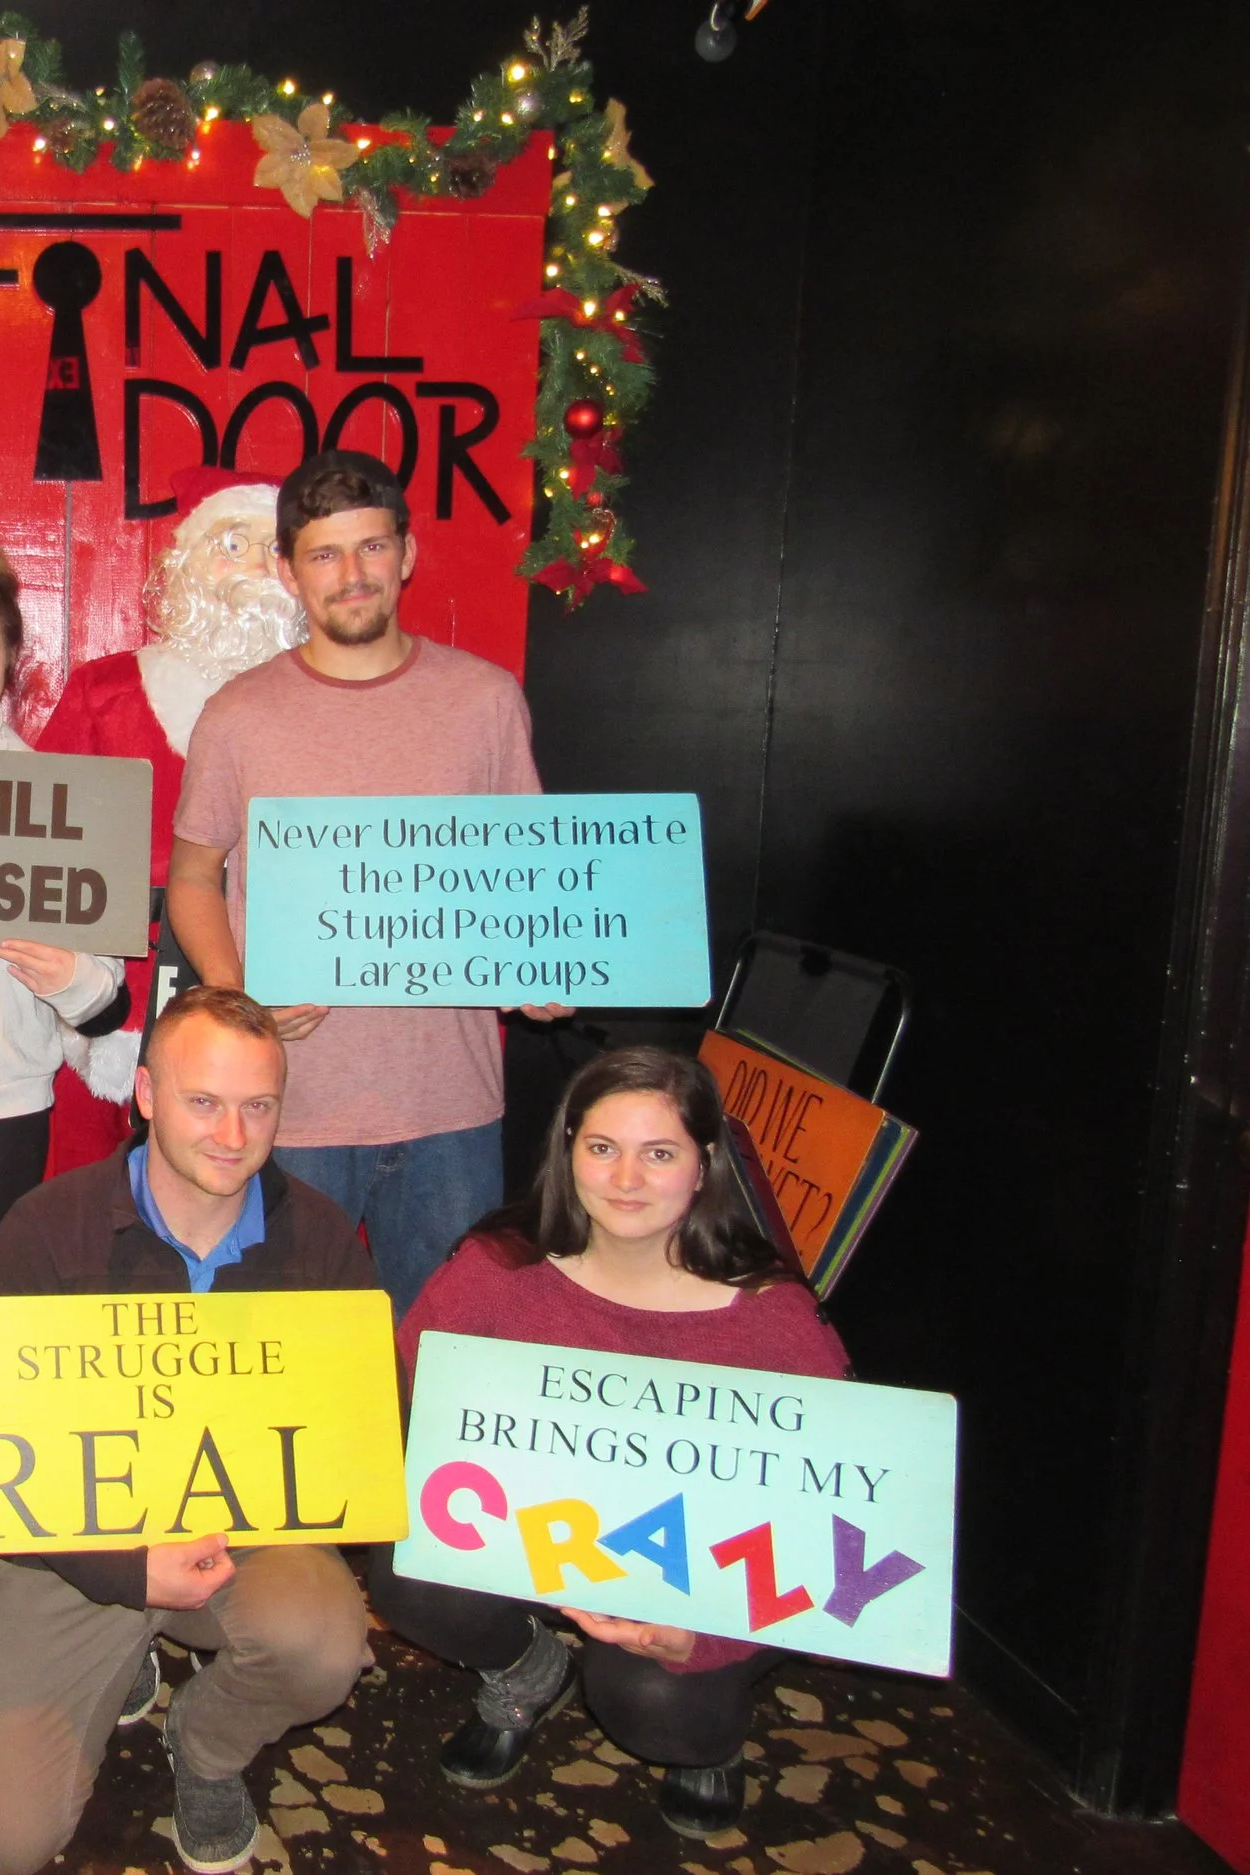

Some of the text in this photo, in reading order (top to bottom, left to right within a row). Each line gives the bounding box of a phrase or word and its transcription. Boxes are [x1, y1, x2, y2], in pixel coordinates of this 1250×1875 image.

[124, 378, 512, 525] DOOR
[257, 814, 687, 851] Never Underestimate
[339, 859, 602, 894] the Power of
[317, 906, 628, 948] Stupid People in
[335, 955, 610, 996] Large Groups
[759, 1079, 823, 1164] WE
[102, 1301, 199, 1337] THE
[18, 1341, 285, 1380] STRUGGLE
[136, 1385, 175, 1419] IS
[539, 1365, 806, 1432] ESCAPING
[458, 1409, 892, 1503] BRINGS OUT MY
[420, 1460, 926, 1633] CRAZY
